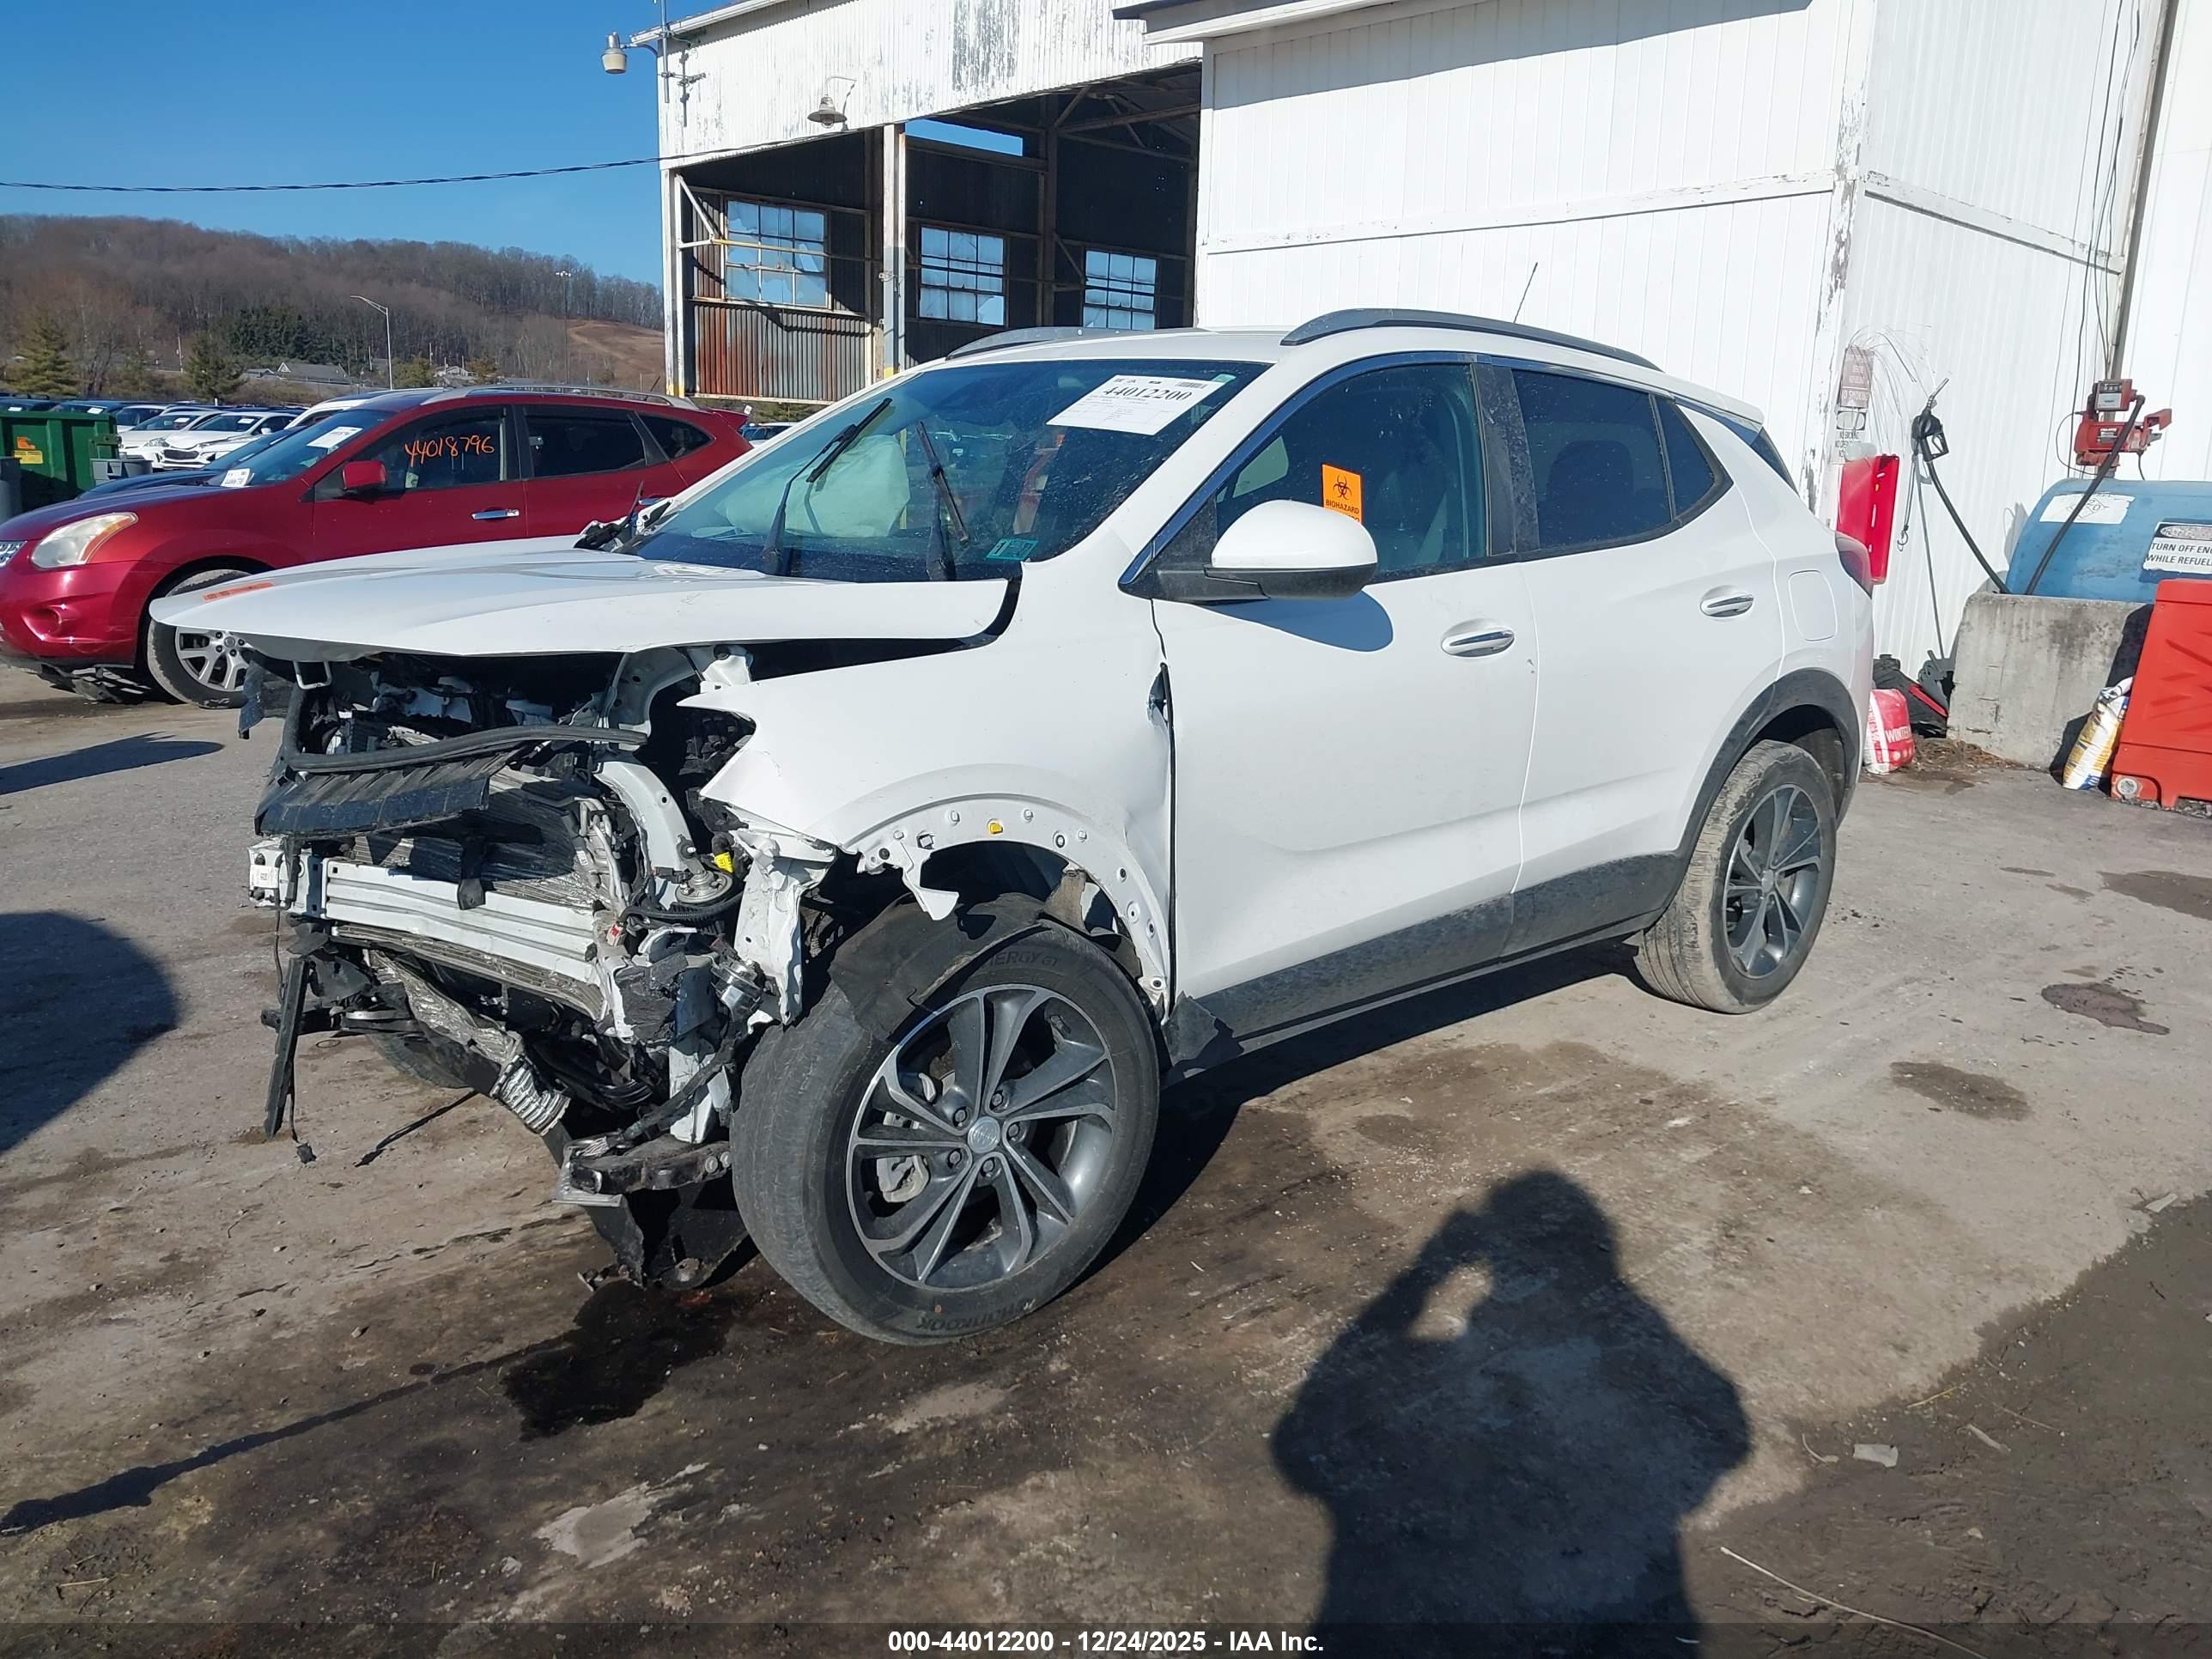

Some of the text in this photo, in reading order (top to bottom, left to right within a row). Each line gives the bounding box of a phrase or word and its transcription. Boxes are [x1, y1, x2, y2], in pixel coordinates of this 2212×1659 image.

[1103, 386, 1193, 400] 44012200
[404, 434, 495, 468] 44018796
[1325, 498, 1360, 514] BIOHAZARD
[2151, 542, 2177, 551] TURN
[2178, 544, 2197, 553] OFF
[2146, 554, 2177, 563] WHILE
